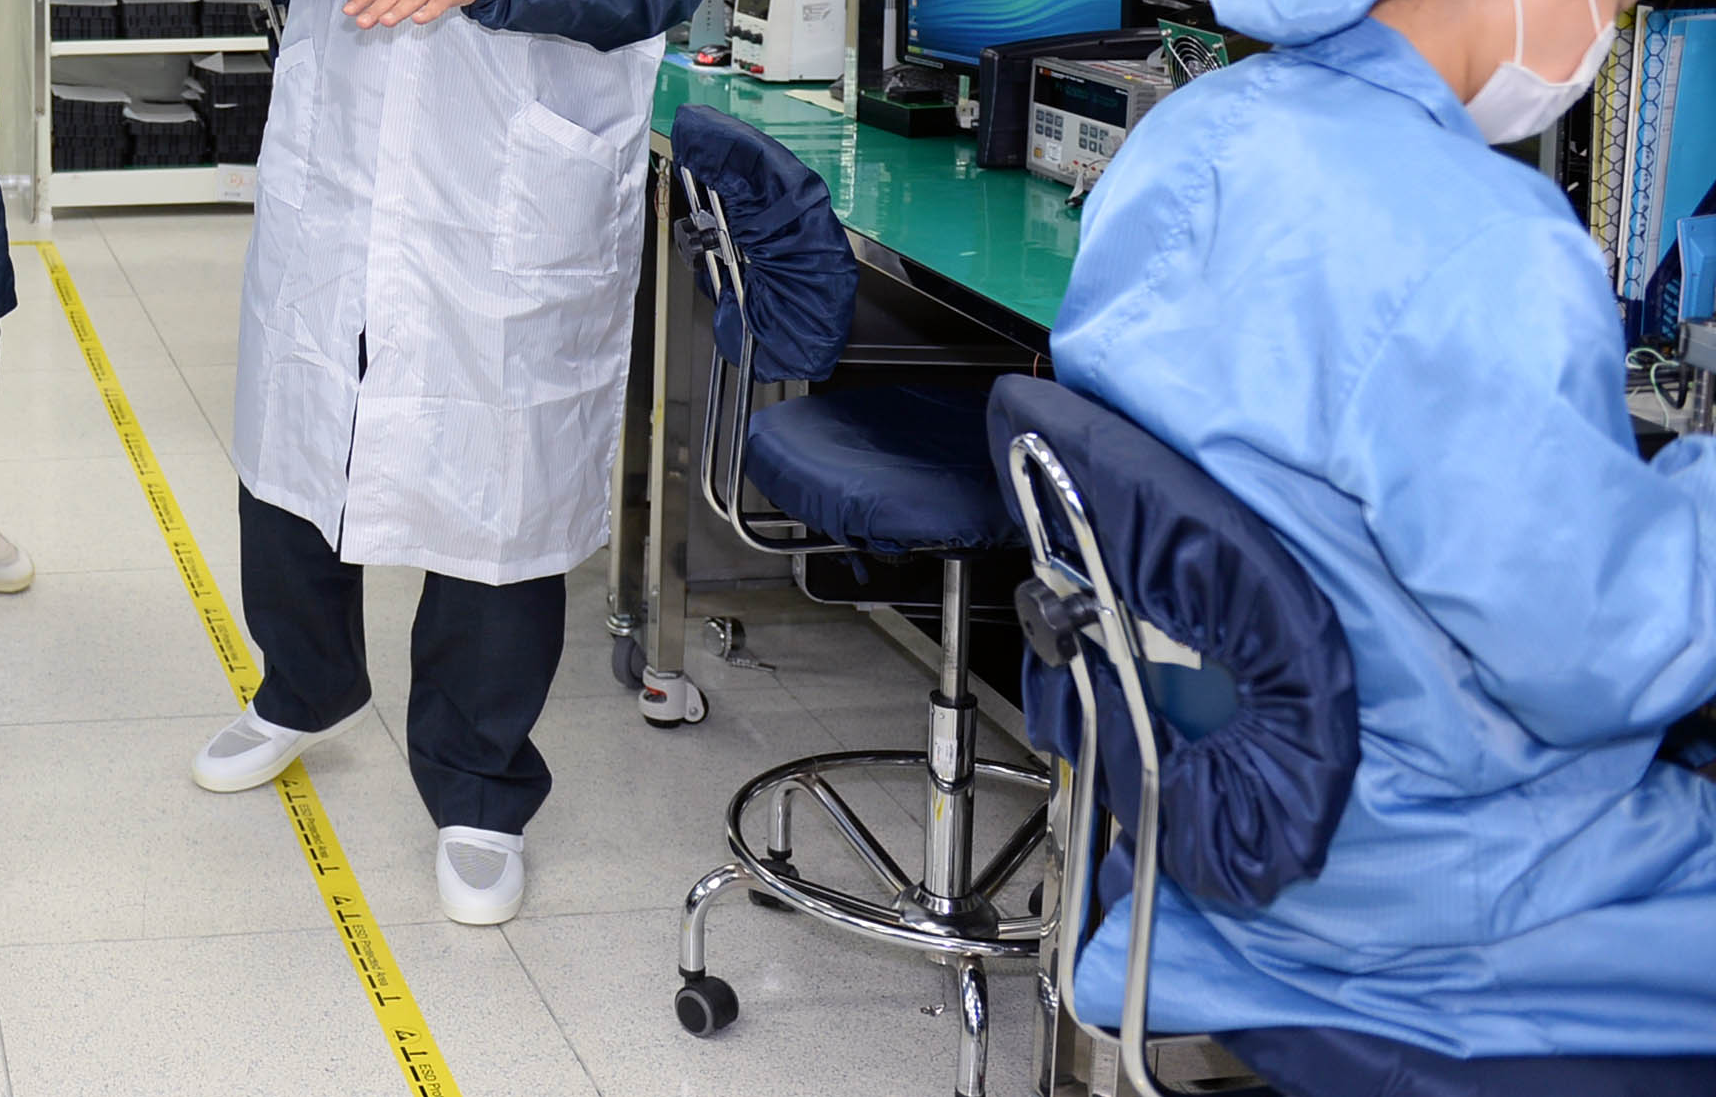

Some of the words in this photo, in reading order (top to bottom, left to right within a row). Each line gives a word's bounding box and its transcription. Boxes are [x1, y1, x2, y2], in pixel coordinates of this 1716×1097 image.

[352, 924, 368, 939] ESD
[360, 940, 382, 972] Protected
[375, 970, 388, 986] Area
[419, 1063, 437, 1081] ESD
